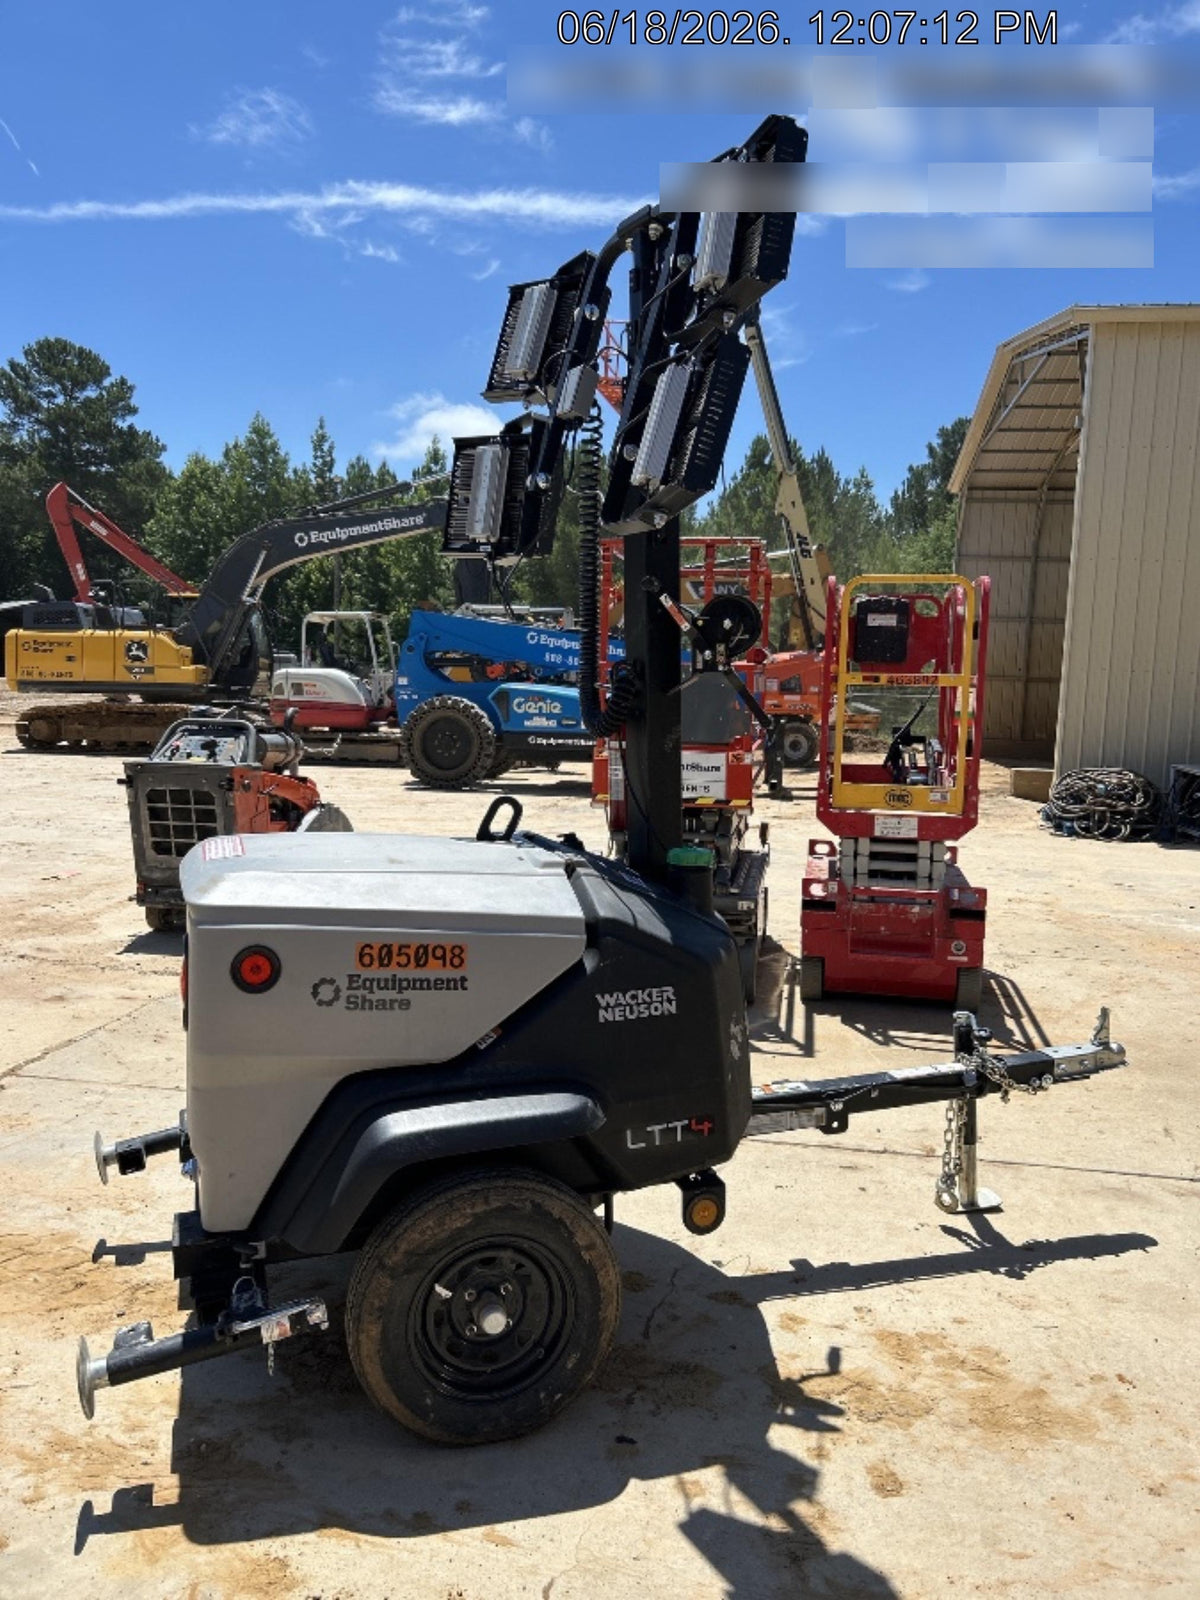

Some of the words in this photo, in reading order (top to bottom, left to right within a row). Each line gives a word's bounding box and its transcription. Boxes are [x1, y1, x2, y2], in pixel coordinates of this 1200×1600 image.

[309, 514, 425, 543] EquipmentShare
[512, 697, 563, 714] Genie
[358, 943, 466, 970] 605098
[345, 974, 468, 994] Equipment
[344, 994, 412, 1012] Share
[595, 986, 677, 1008] WACKER
[598, 1000, 677, 1024] NEUSON
